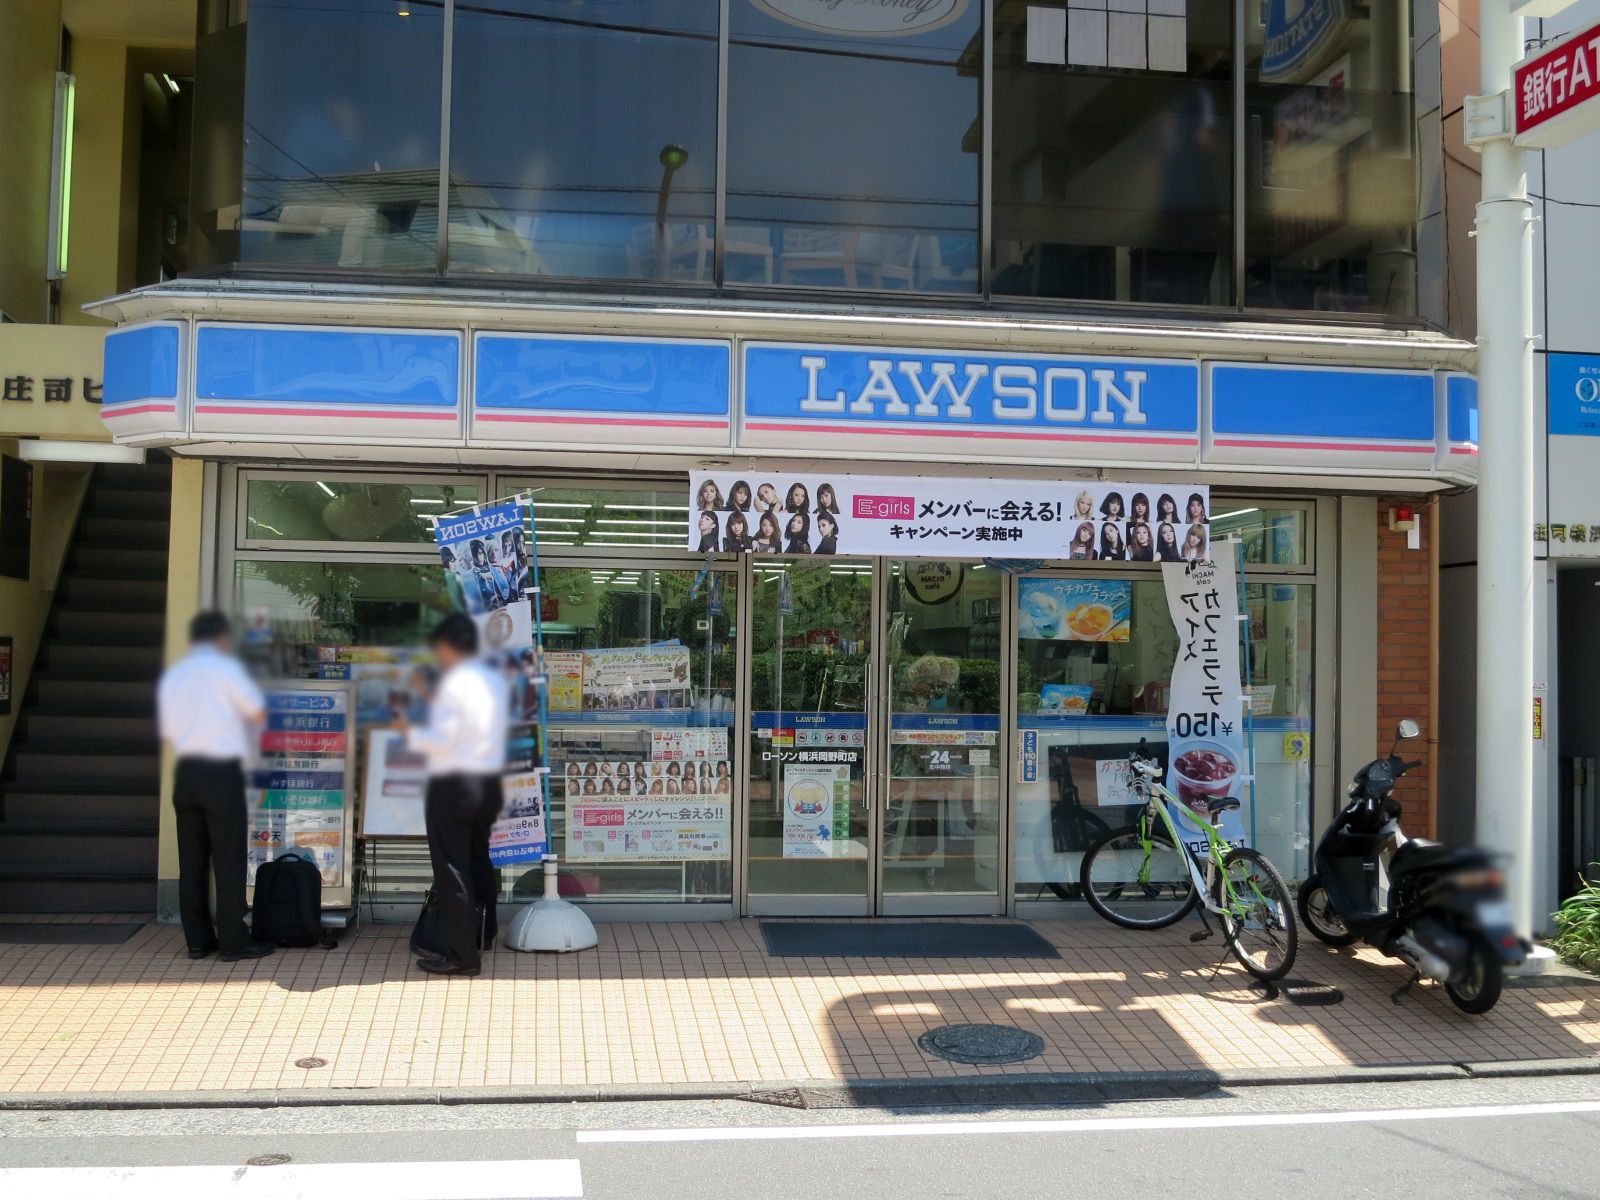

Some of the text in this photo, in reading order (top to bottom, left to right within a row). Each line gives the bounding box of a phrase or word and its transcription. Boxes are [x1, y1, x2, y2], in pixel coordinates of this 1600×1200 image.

[799, 355, 1149, 425] LAWSON
[857, 498, 911, 518] E-girls
[889, 524, 1024, 542] キャンペーン実施中
[1054, 583, 1101, 595] ウチカフェ
[1090, 590, 1127, 602] フラッペ
[283, 717, 331, 729] 浜銀行
[930, 750, 950, 764] 24
